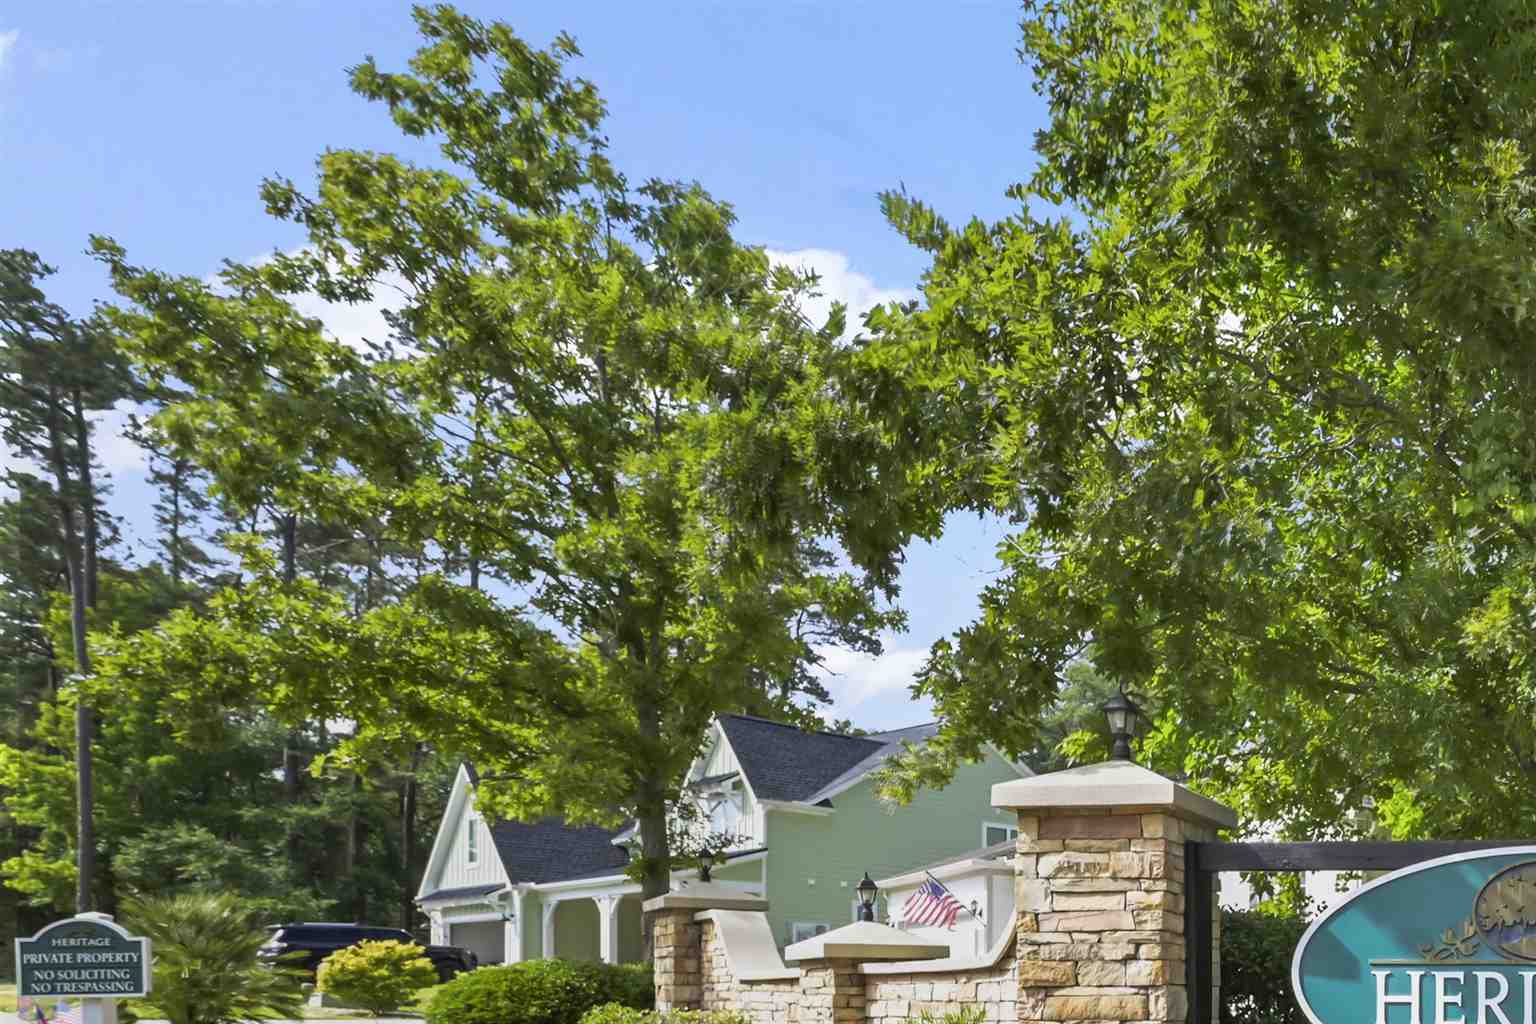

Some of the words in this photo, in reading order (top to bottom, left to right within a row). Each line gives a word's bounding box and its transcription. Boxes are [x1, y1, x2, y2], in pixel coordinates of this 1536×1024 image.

[51, 937, 111, 947] HERITAGE
[23, 953, 73, 964] PRIVATE
[76, 952, 139, 962] PROPERTY
[33, 970, 55, 980] NO
[57, 969, 131, 980] SOLICITING
[31, 983, 52, 993] NO
[54, 981, 134, 992] TRESPASSING
